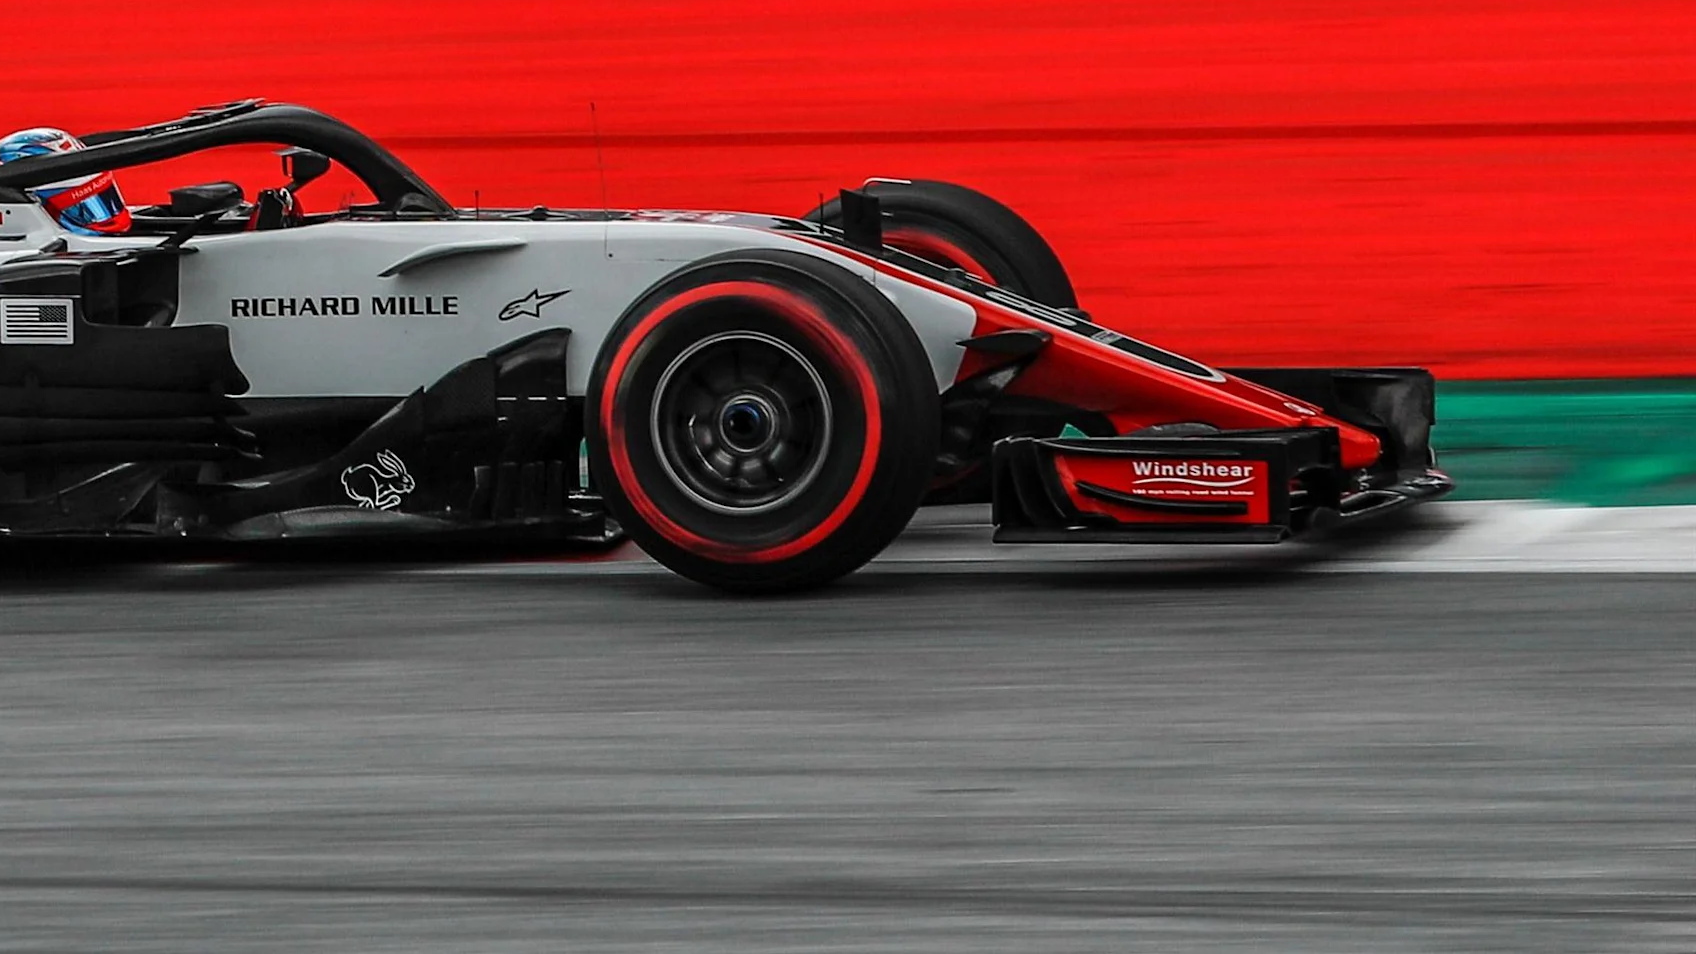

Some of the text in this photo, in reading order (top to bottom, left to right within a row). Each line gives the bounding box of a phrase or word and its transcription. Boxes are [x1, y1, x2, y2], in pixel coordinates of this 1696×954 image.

[231, 296, 459, 317] RICHARD MILLE
[1132, 461, 1254, 477] Windshear
